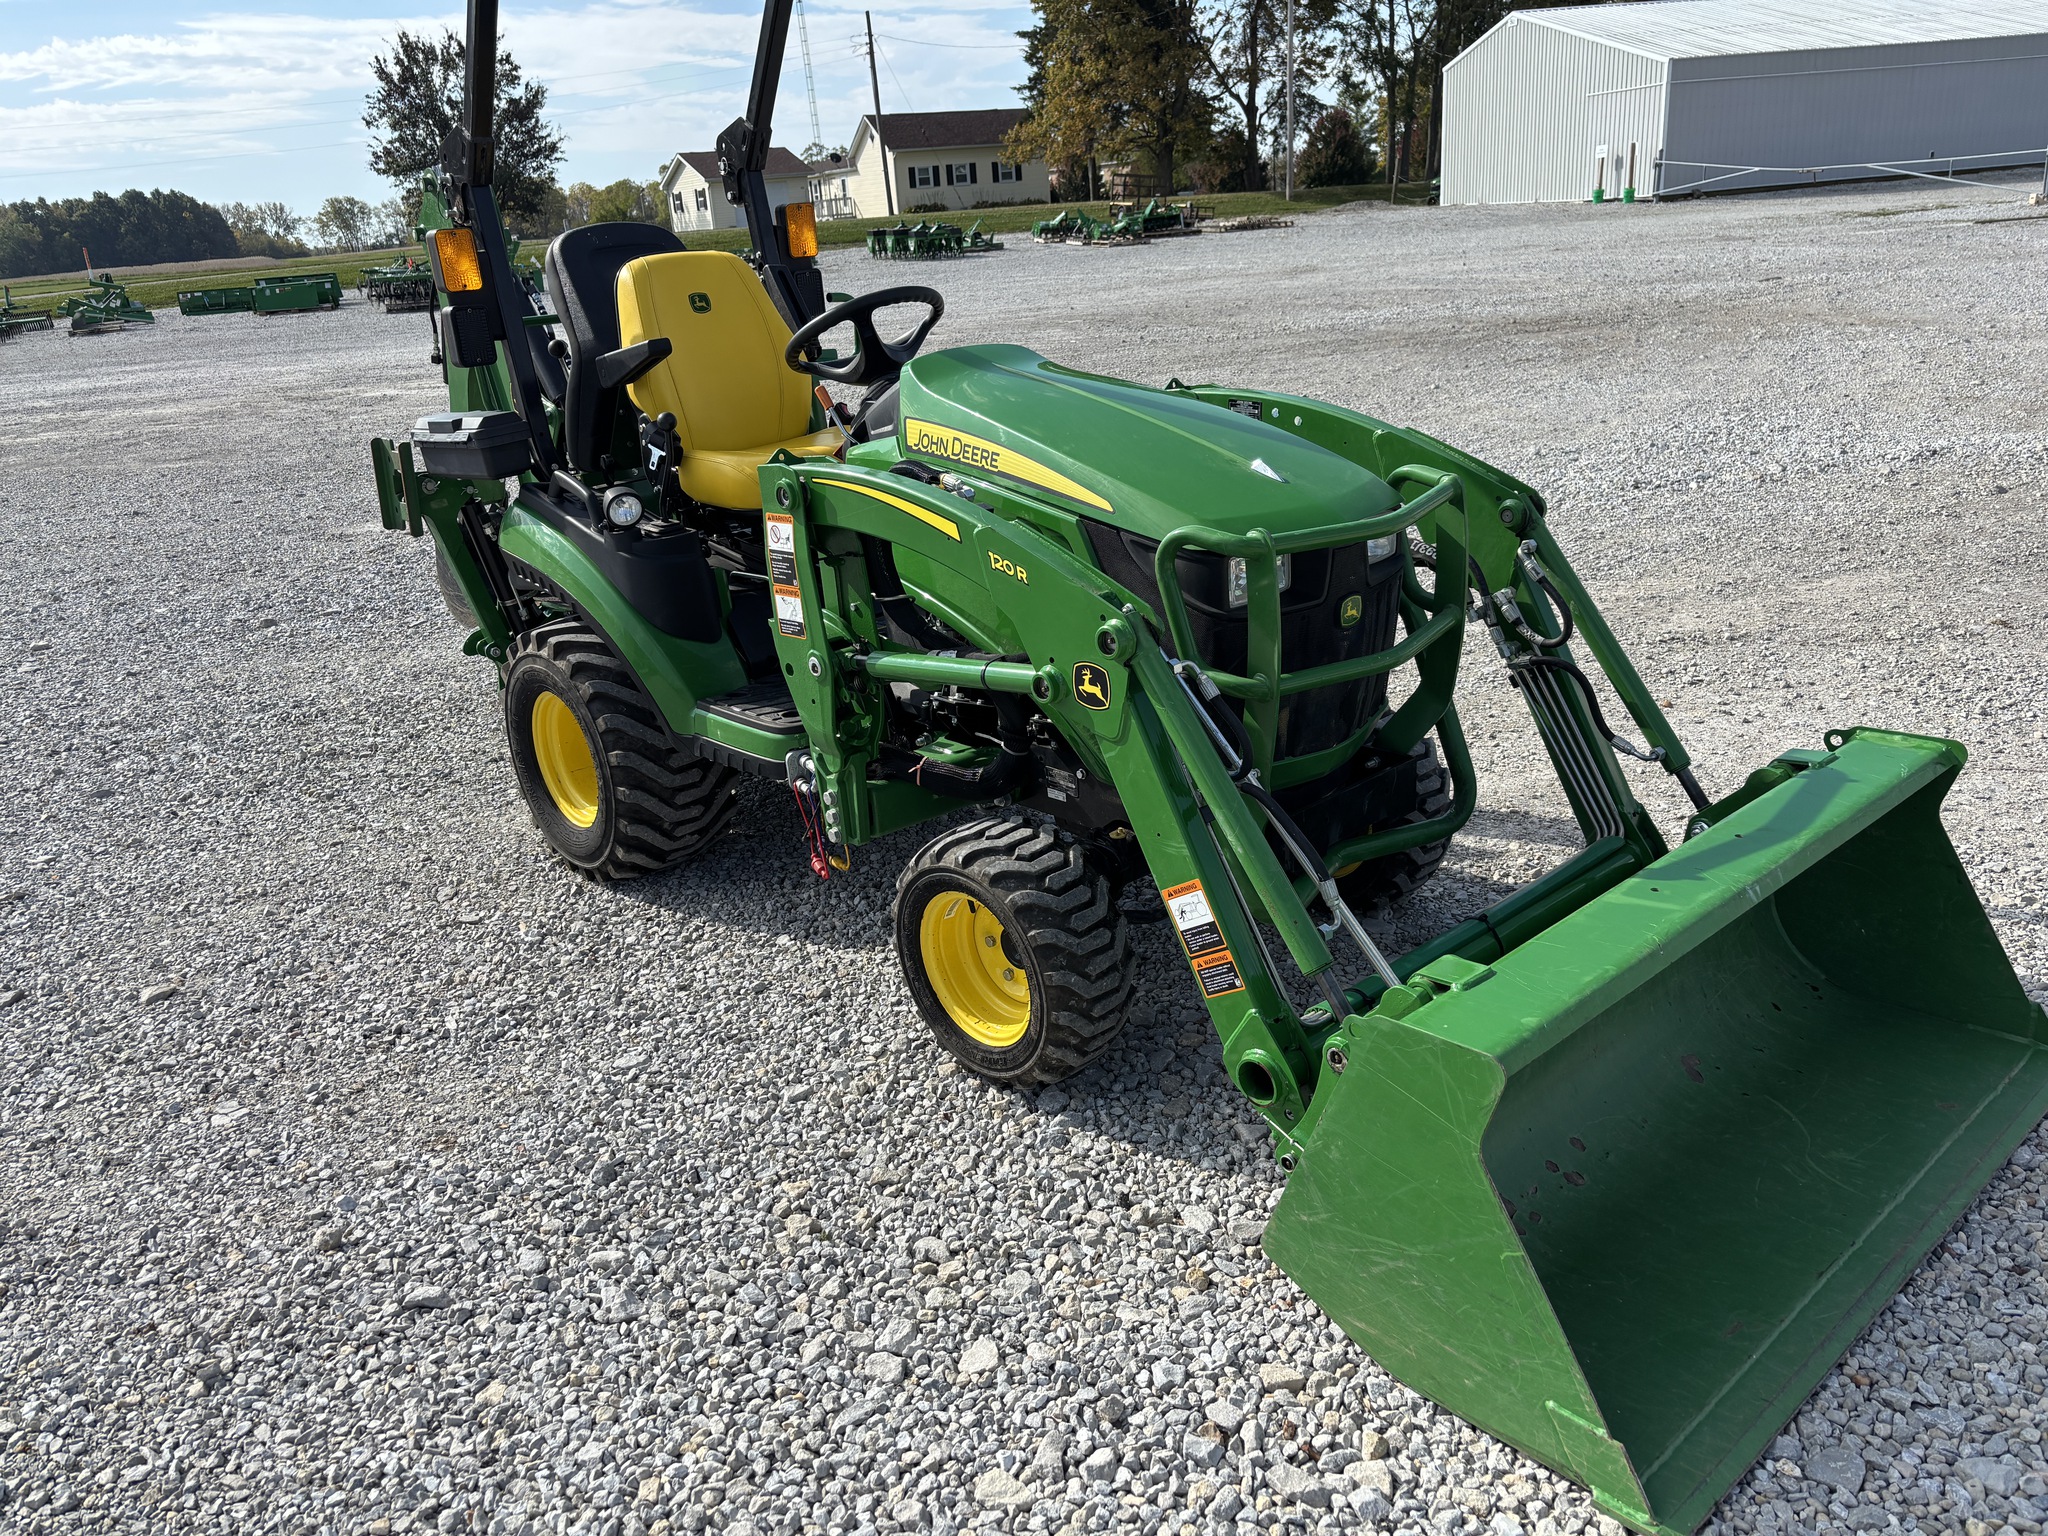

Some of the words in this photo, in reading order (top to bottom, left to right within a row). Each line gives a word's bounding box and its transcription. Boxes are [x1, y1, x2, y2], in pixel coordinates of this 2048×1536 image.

[913, 429, 949, 455] JOHN
[951, 437, 1000, 469] DEERE
[771, 514, 793, 523] WARNING
[1172, 883, 1198, 896] WARNING
[1203, 955, 1229, 965] WARNING
